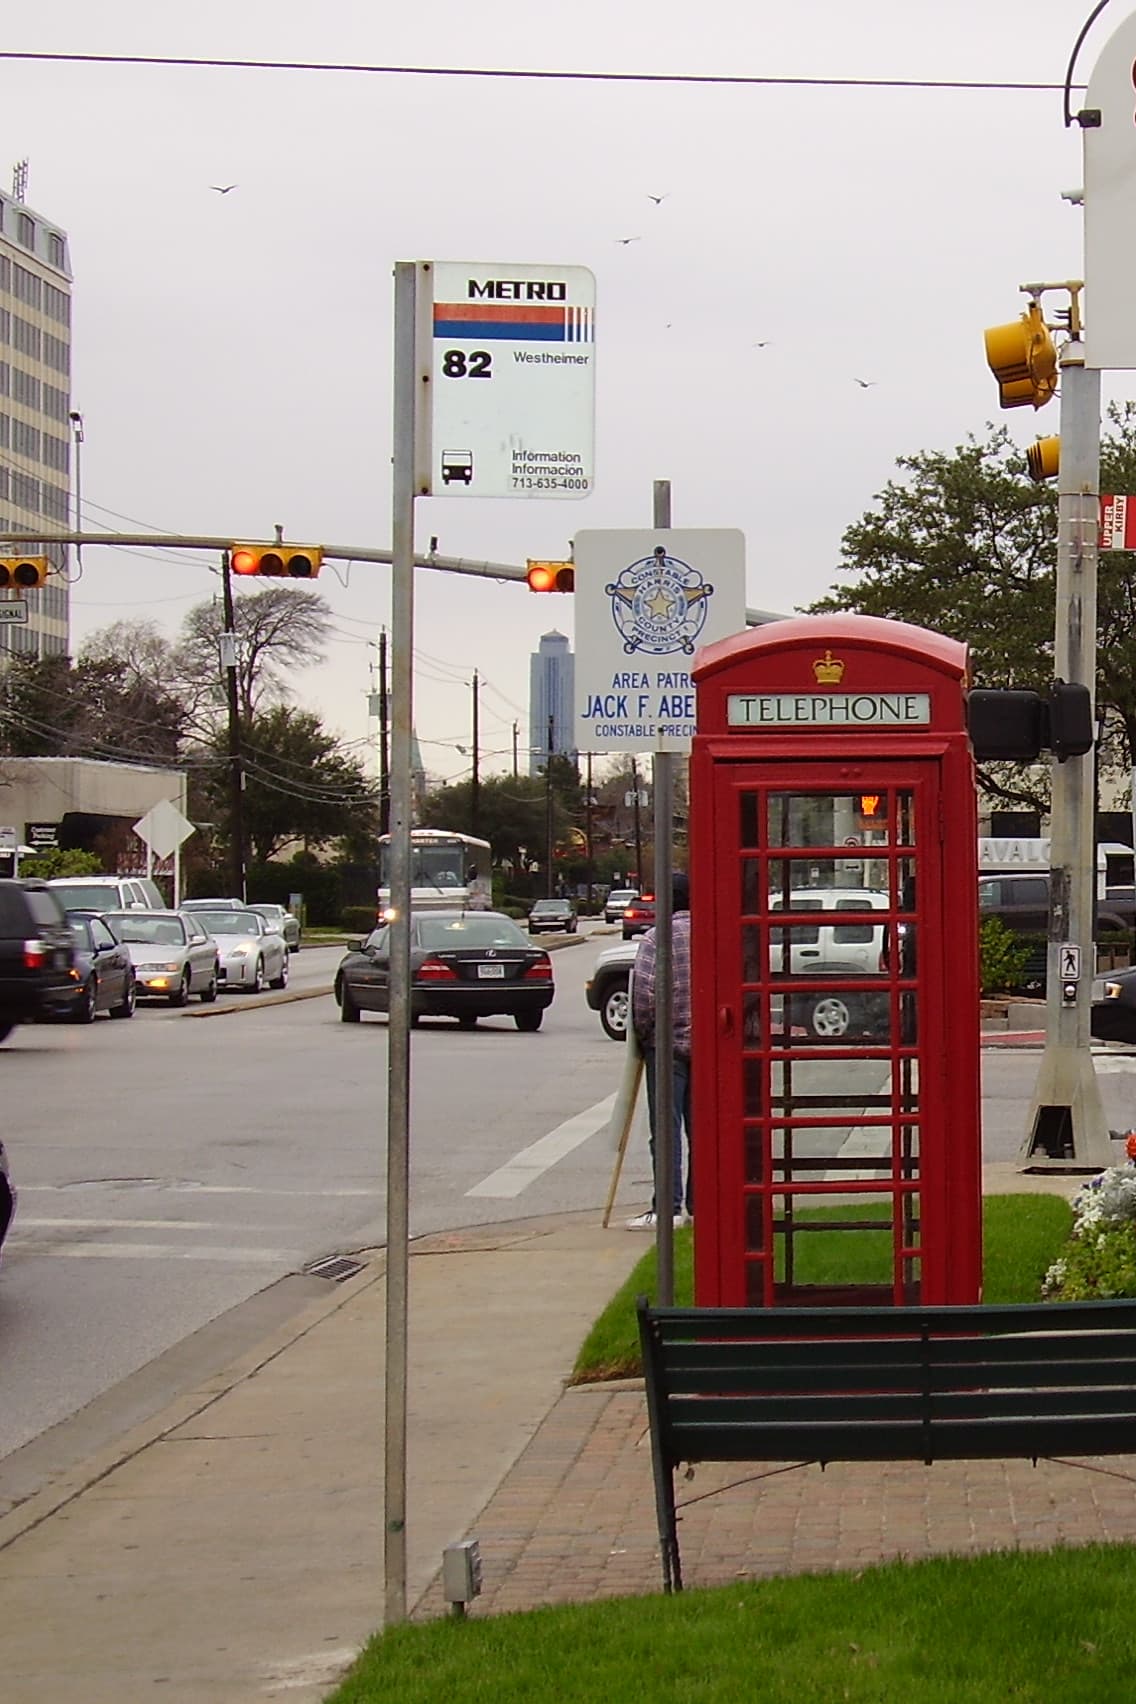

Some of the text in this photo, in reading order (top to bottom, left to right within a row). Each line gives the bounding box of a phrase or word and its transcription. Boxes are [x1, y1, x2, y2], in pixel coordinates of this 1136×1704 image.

[468, 280, 566, 300] METRO
[442, 350, 492, 378] 82
[513, 351, 589, 365] Westheimer
[512, 450, 581, 463] Information
[512, 477, 588, 490] 713-635-4000
[1115, 497, 1125, 532] KIRBY
[1103, 505, 1114, 546] UPPER
[631, 568, 690, 585] CONSTABLE
[639, 578, 681, 595] HARRIS
[638, 616, 680, 632] COUNTY
[631, 626, 681, 643] PRECINCT
[612, 673, 650, 688] AREA
[581, 695, 695, 718] JACK F. ABE
[739, 696, 919, 722] TELEPHONE
[595, 725, 656, 737] CONSTABLE
